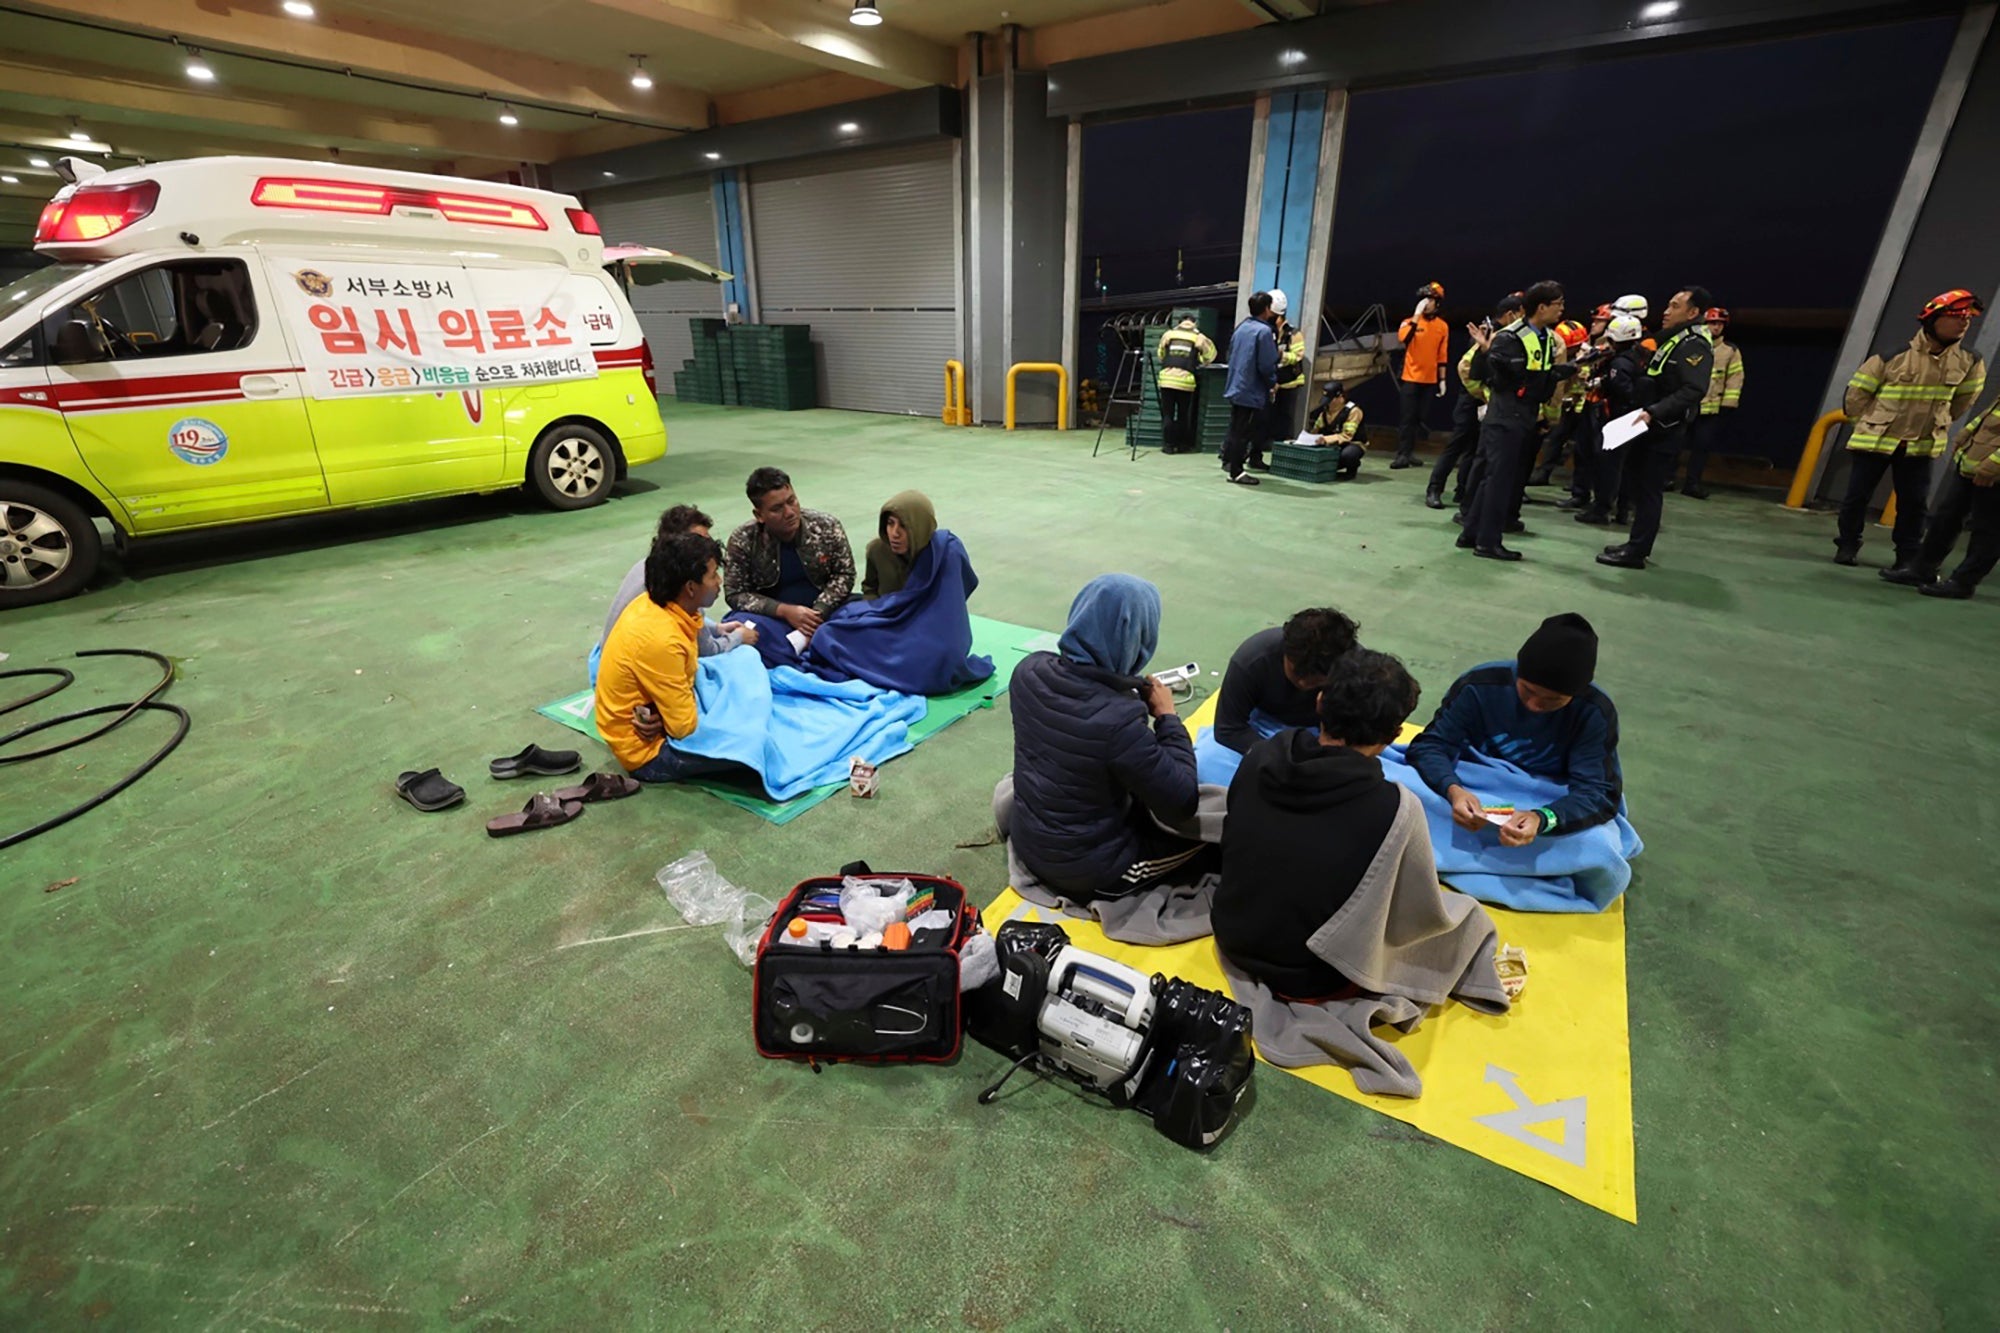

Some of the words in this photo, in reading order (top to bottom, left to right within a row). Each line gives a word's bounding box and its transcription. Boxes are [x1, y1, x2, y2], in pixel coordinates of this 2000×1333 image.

[347, 277, 454, 299] 서부소방서
[307, 303, 422, 356] 임시
[437, 306, 573, 354] 의료소
[475, 365, 518, 382] 순으로
[520, 357, 587, 378] 처치합니다.
[172, 429, 200, 448] 119
